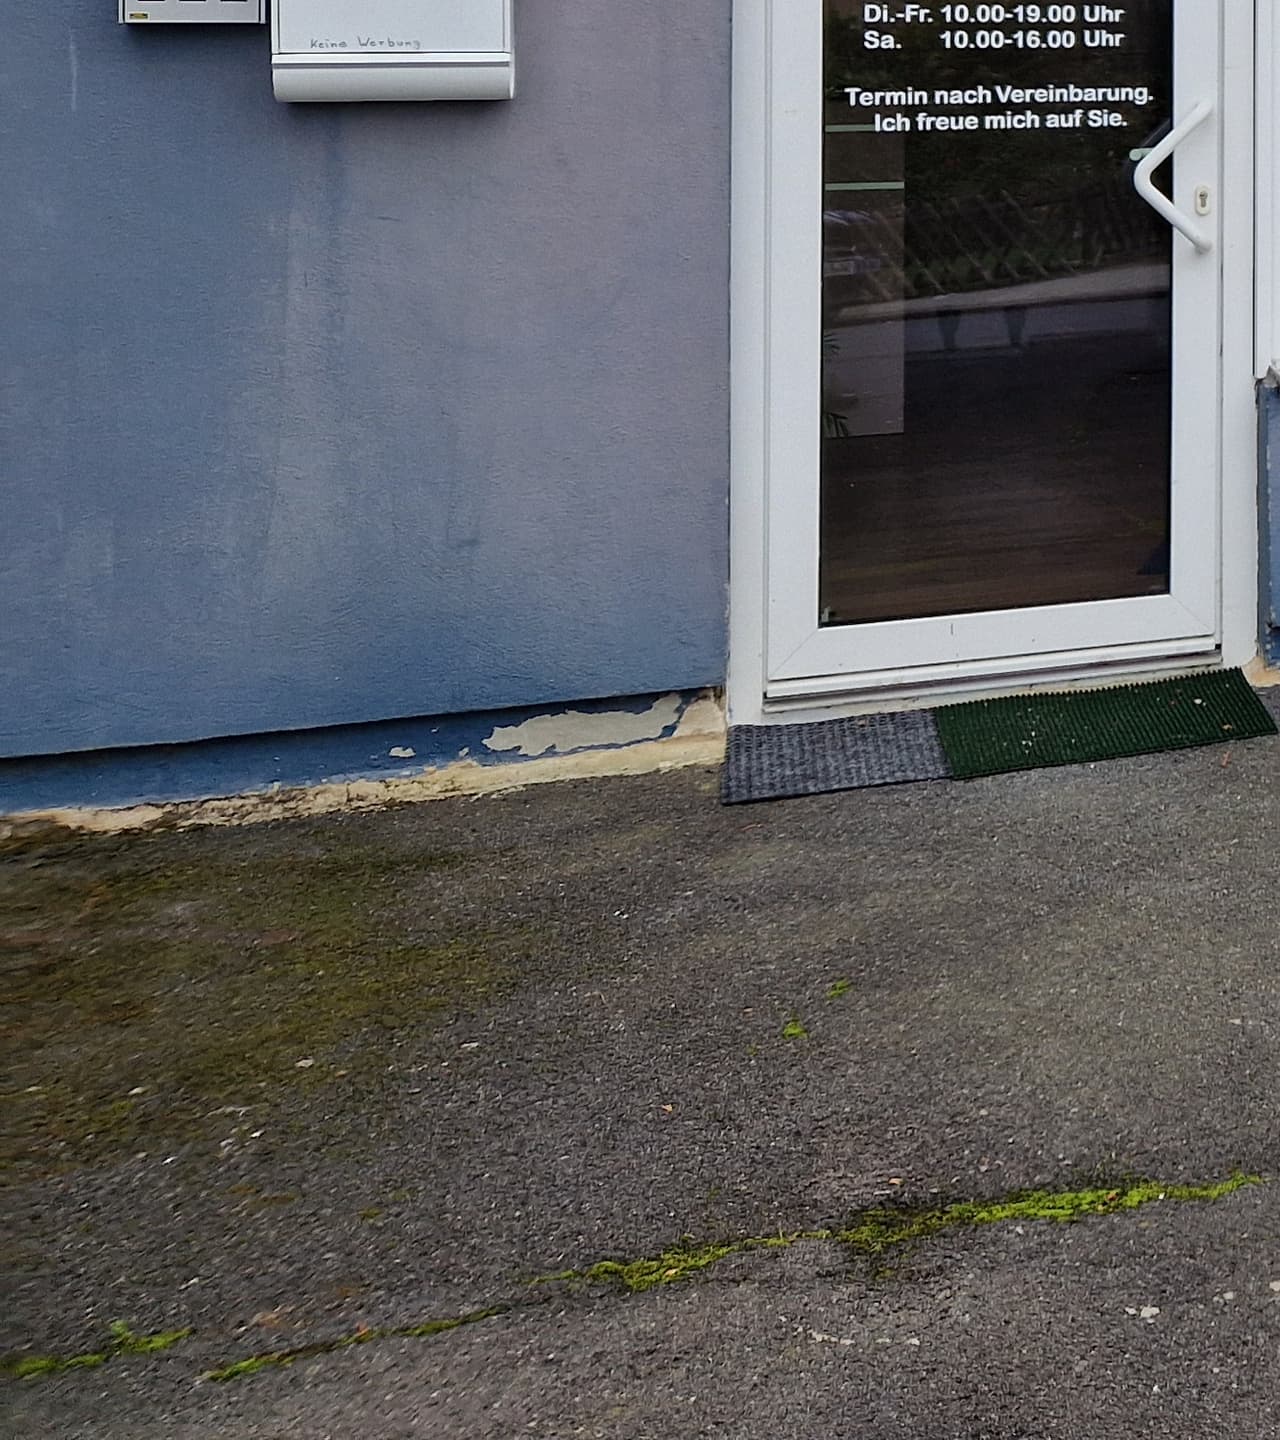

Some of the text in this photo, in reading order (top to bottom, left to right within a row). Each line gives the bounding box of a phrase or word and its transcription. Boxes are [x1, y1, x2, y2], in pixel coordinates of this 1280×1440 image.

[864, 4, 1125, 23] Di.-Fr. 10.00-19.00 Uhr
[310, 37, 421, 49] Keine Werbung
[863, 29, 1125, 49] Sa. 10.00-16.00 Uhr
[844, 84, 1154, 106] Termin nach Vereinbarung.
[874, 109, 1128, 132] Ich freue mich auf Sie.
